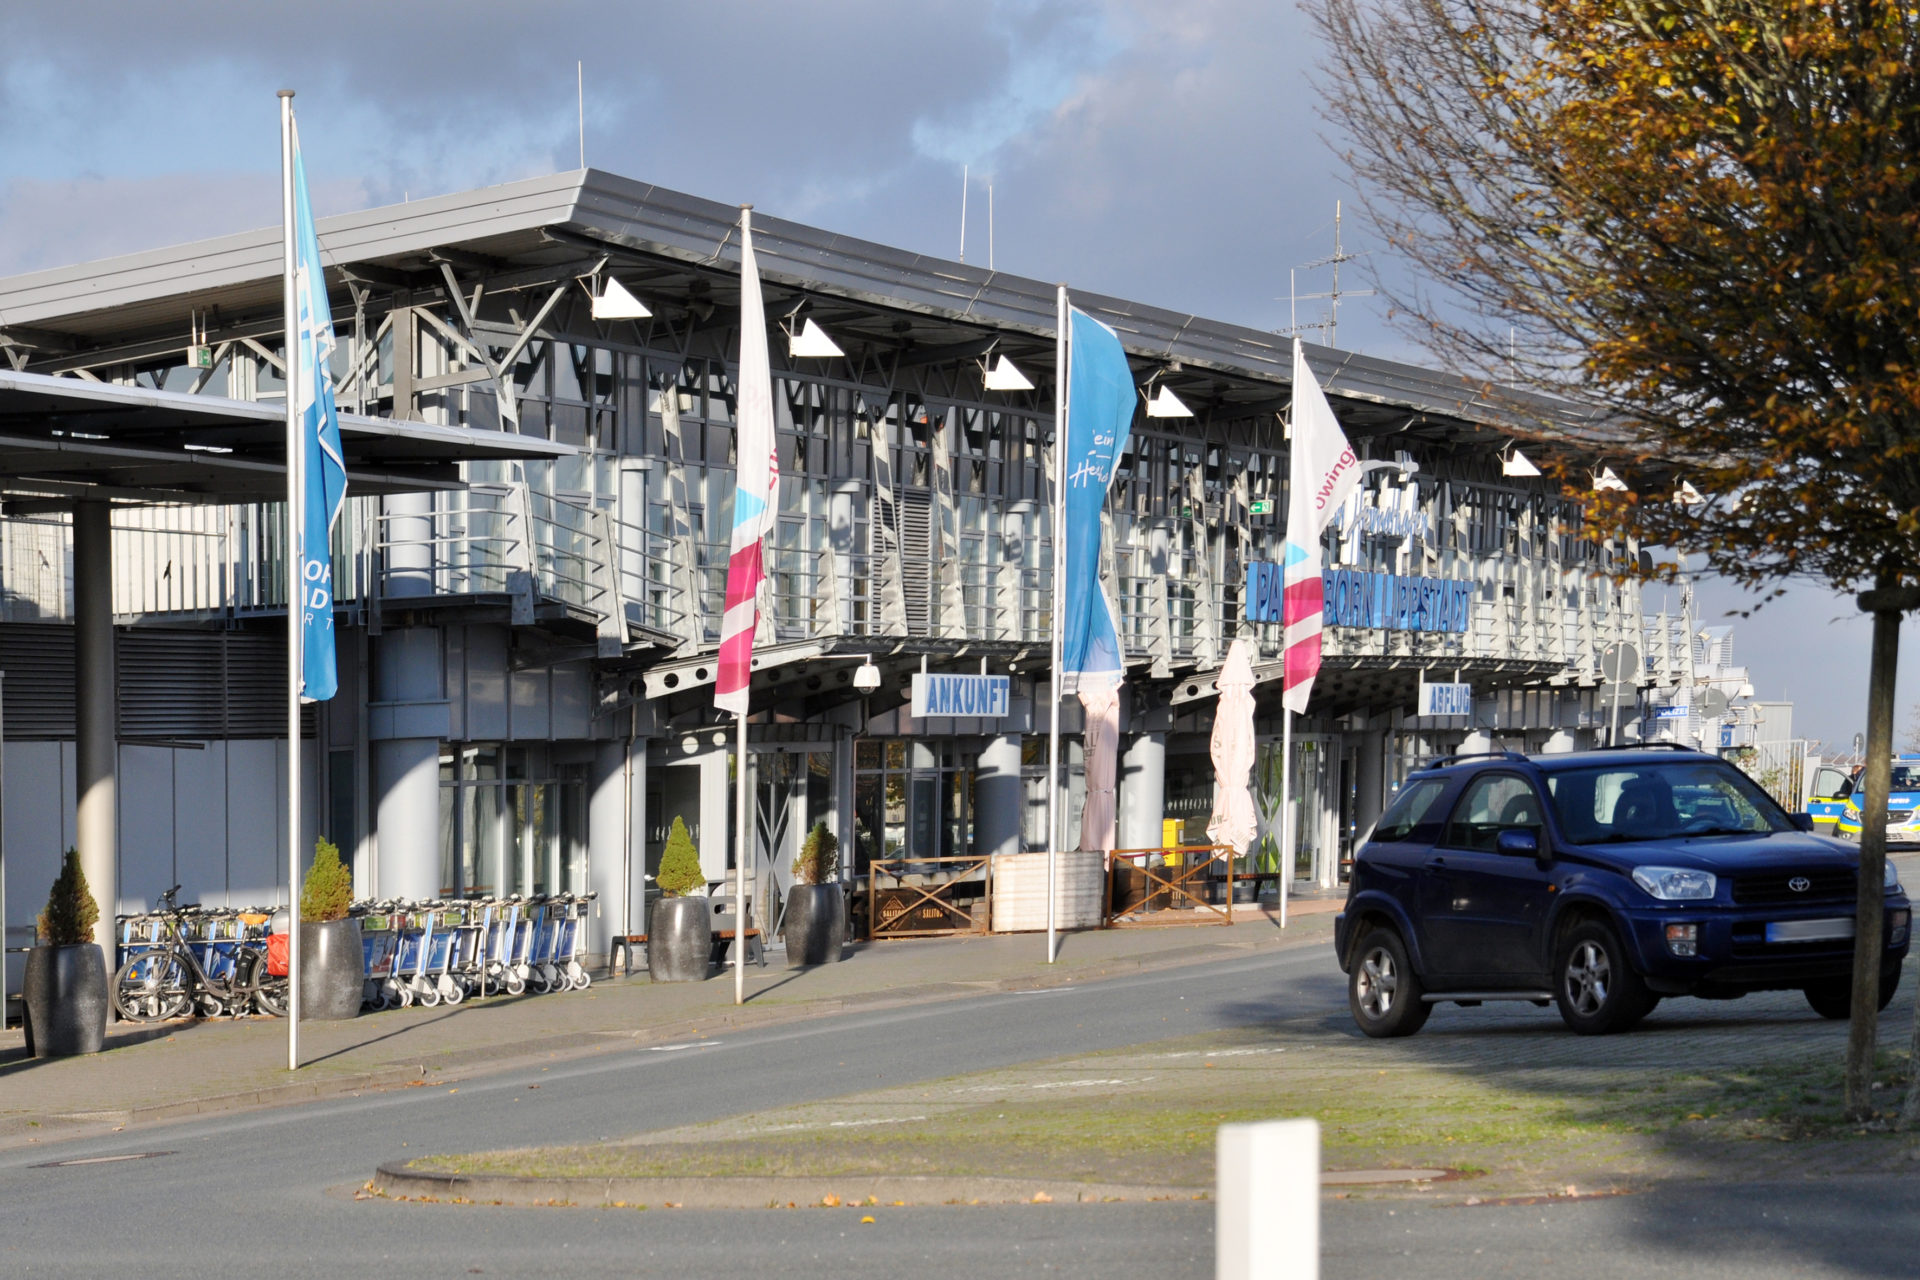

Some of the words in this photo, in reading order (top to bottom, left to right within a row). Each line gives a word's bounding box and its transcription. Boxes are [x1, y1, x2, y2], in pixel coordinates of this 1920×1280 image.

[1256, 561, 1376, 628] PABORN
[1381, 573, 1474, 632] LIPPSTADT
[926, 677, 1009, 714] ANKUNFT
[1430, 686, 1470, 713] ABFLUG
